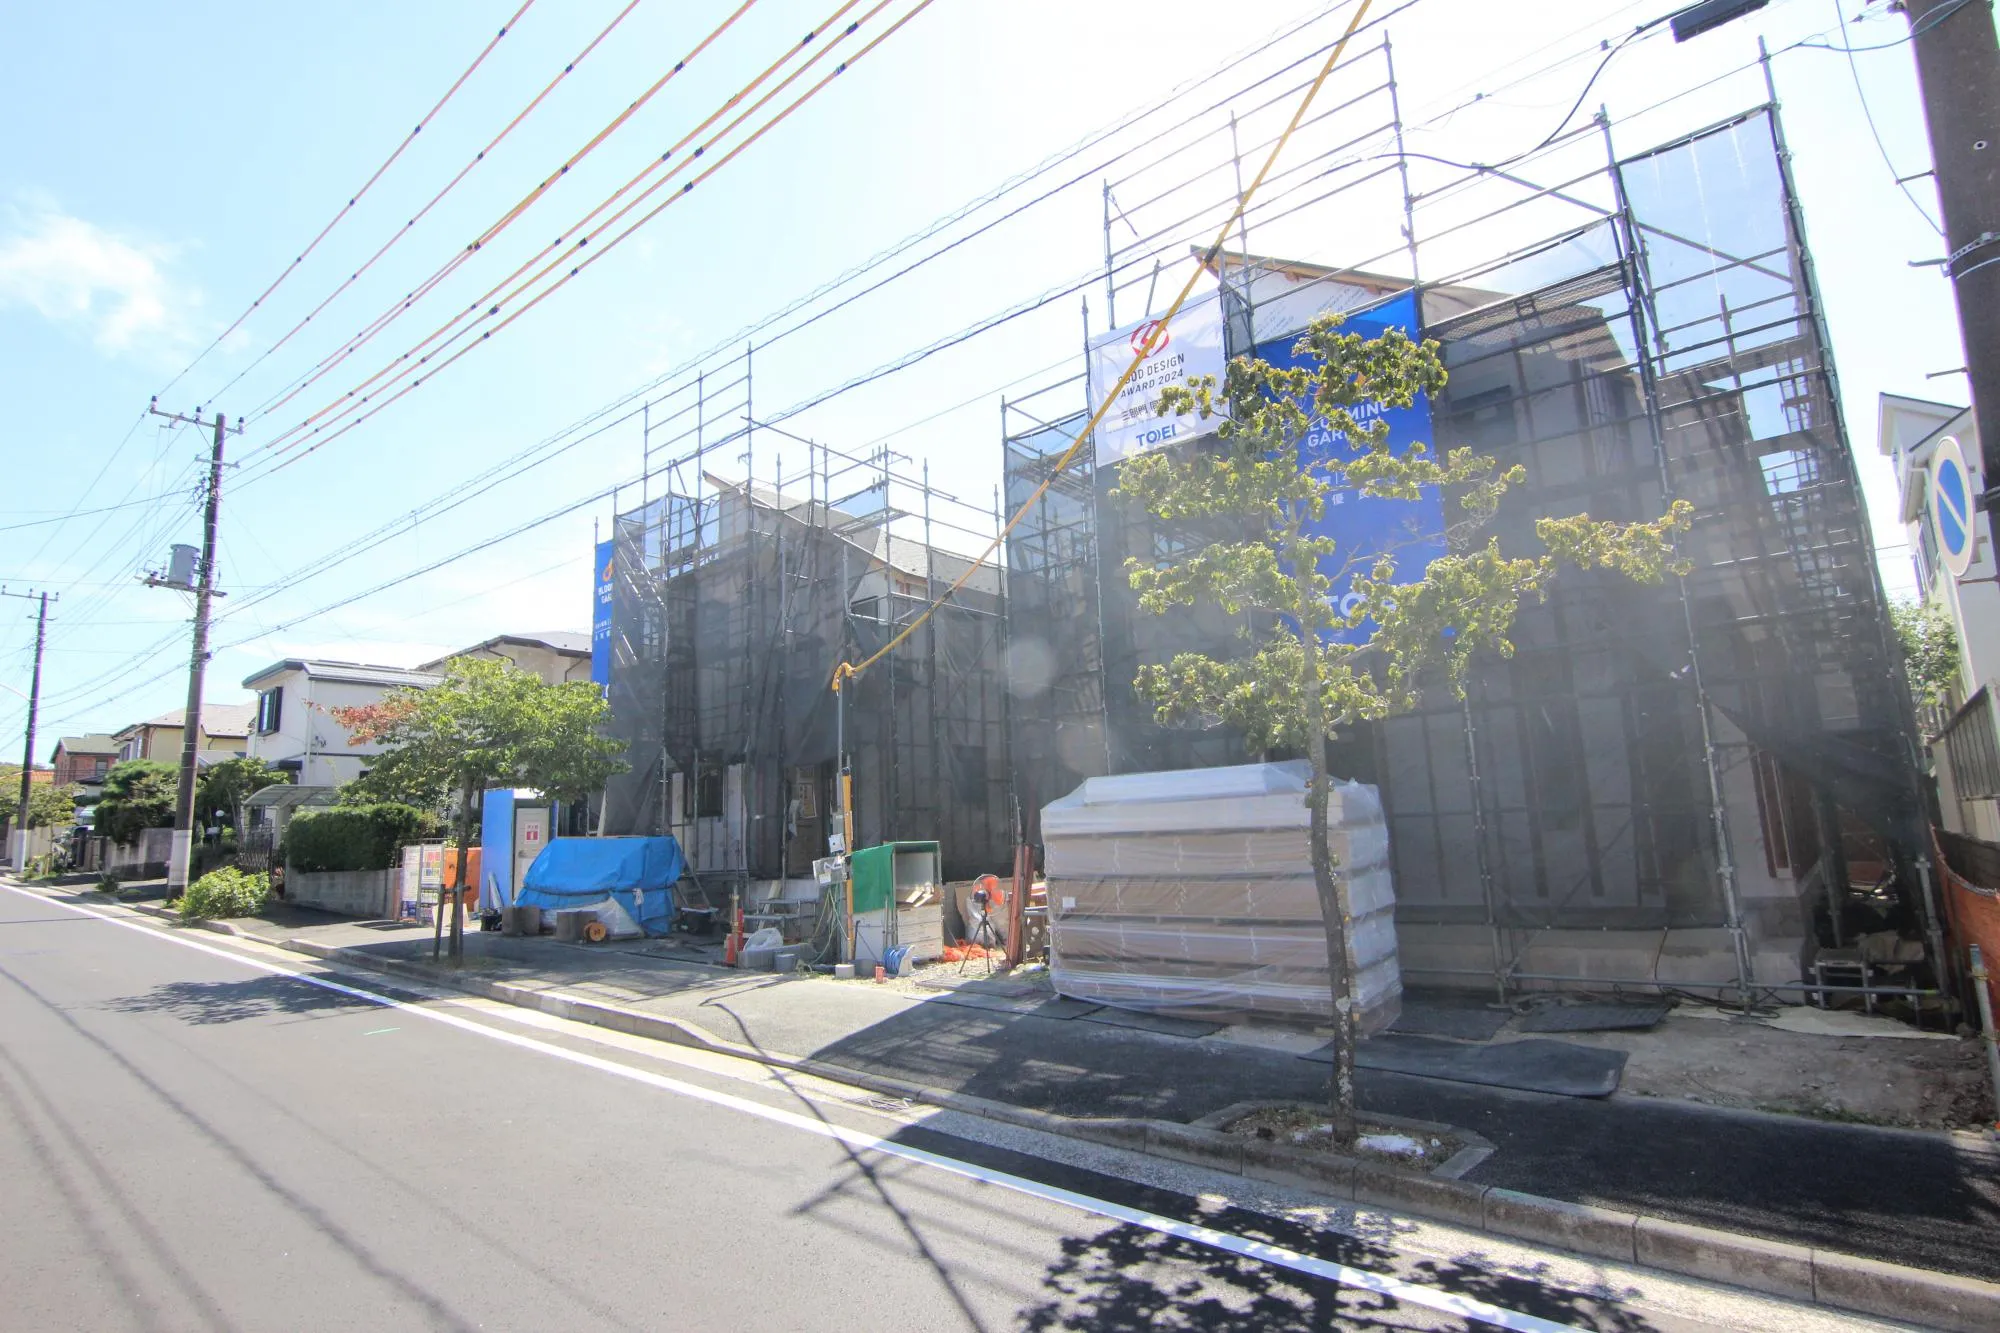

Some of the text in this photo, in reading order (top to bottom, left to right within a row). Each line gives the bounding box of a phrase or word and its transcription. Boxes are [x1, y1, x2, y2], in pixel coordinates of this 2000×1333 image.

[1147, 353, 1185, 376] DESIGN
[1121, 368, 1184, 398] AWARD 2024
[1136, 423, 1177, 447] TOEI
[1308, 416, 1385, 448] GARE
